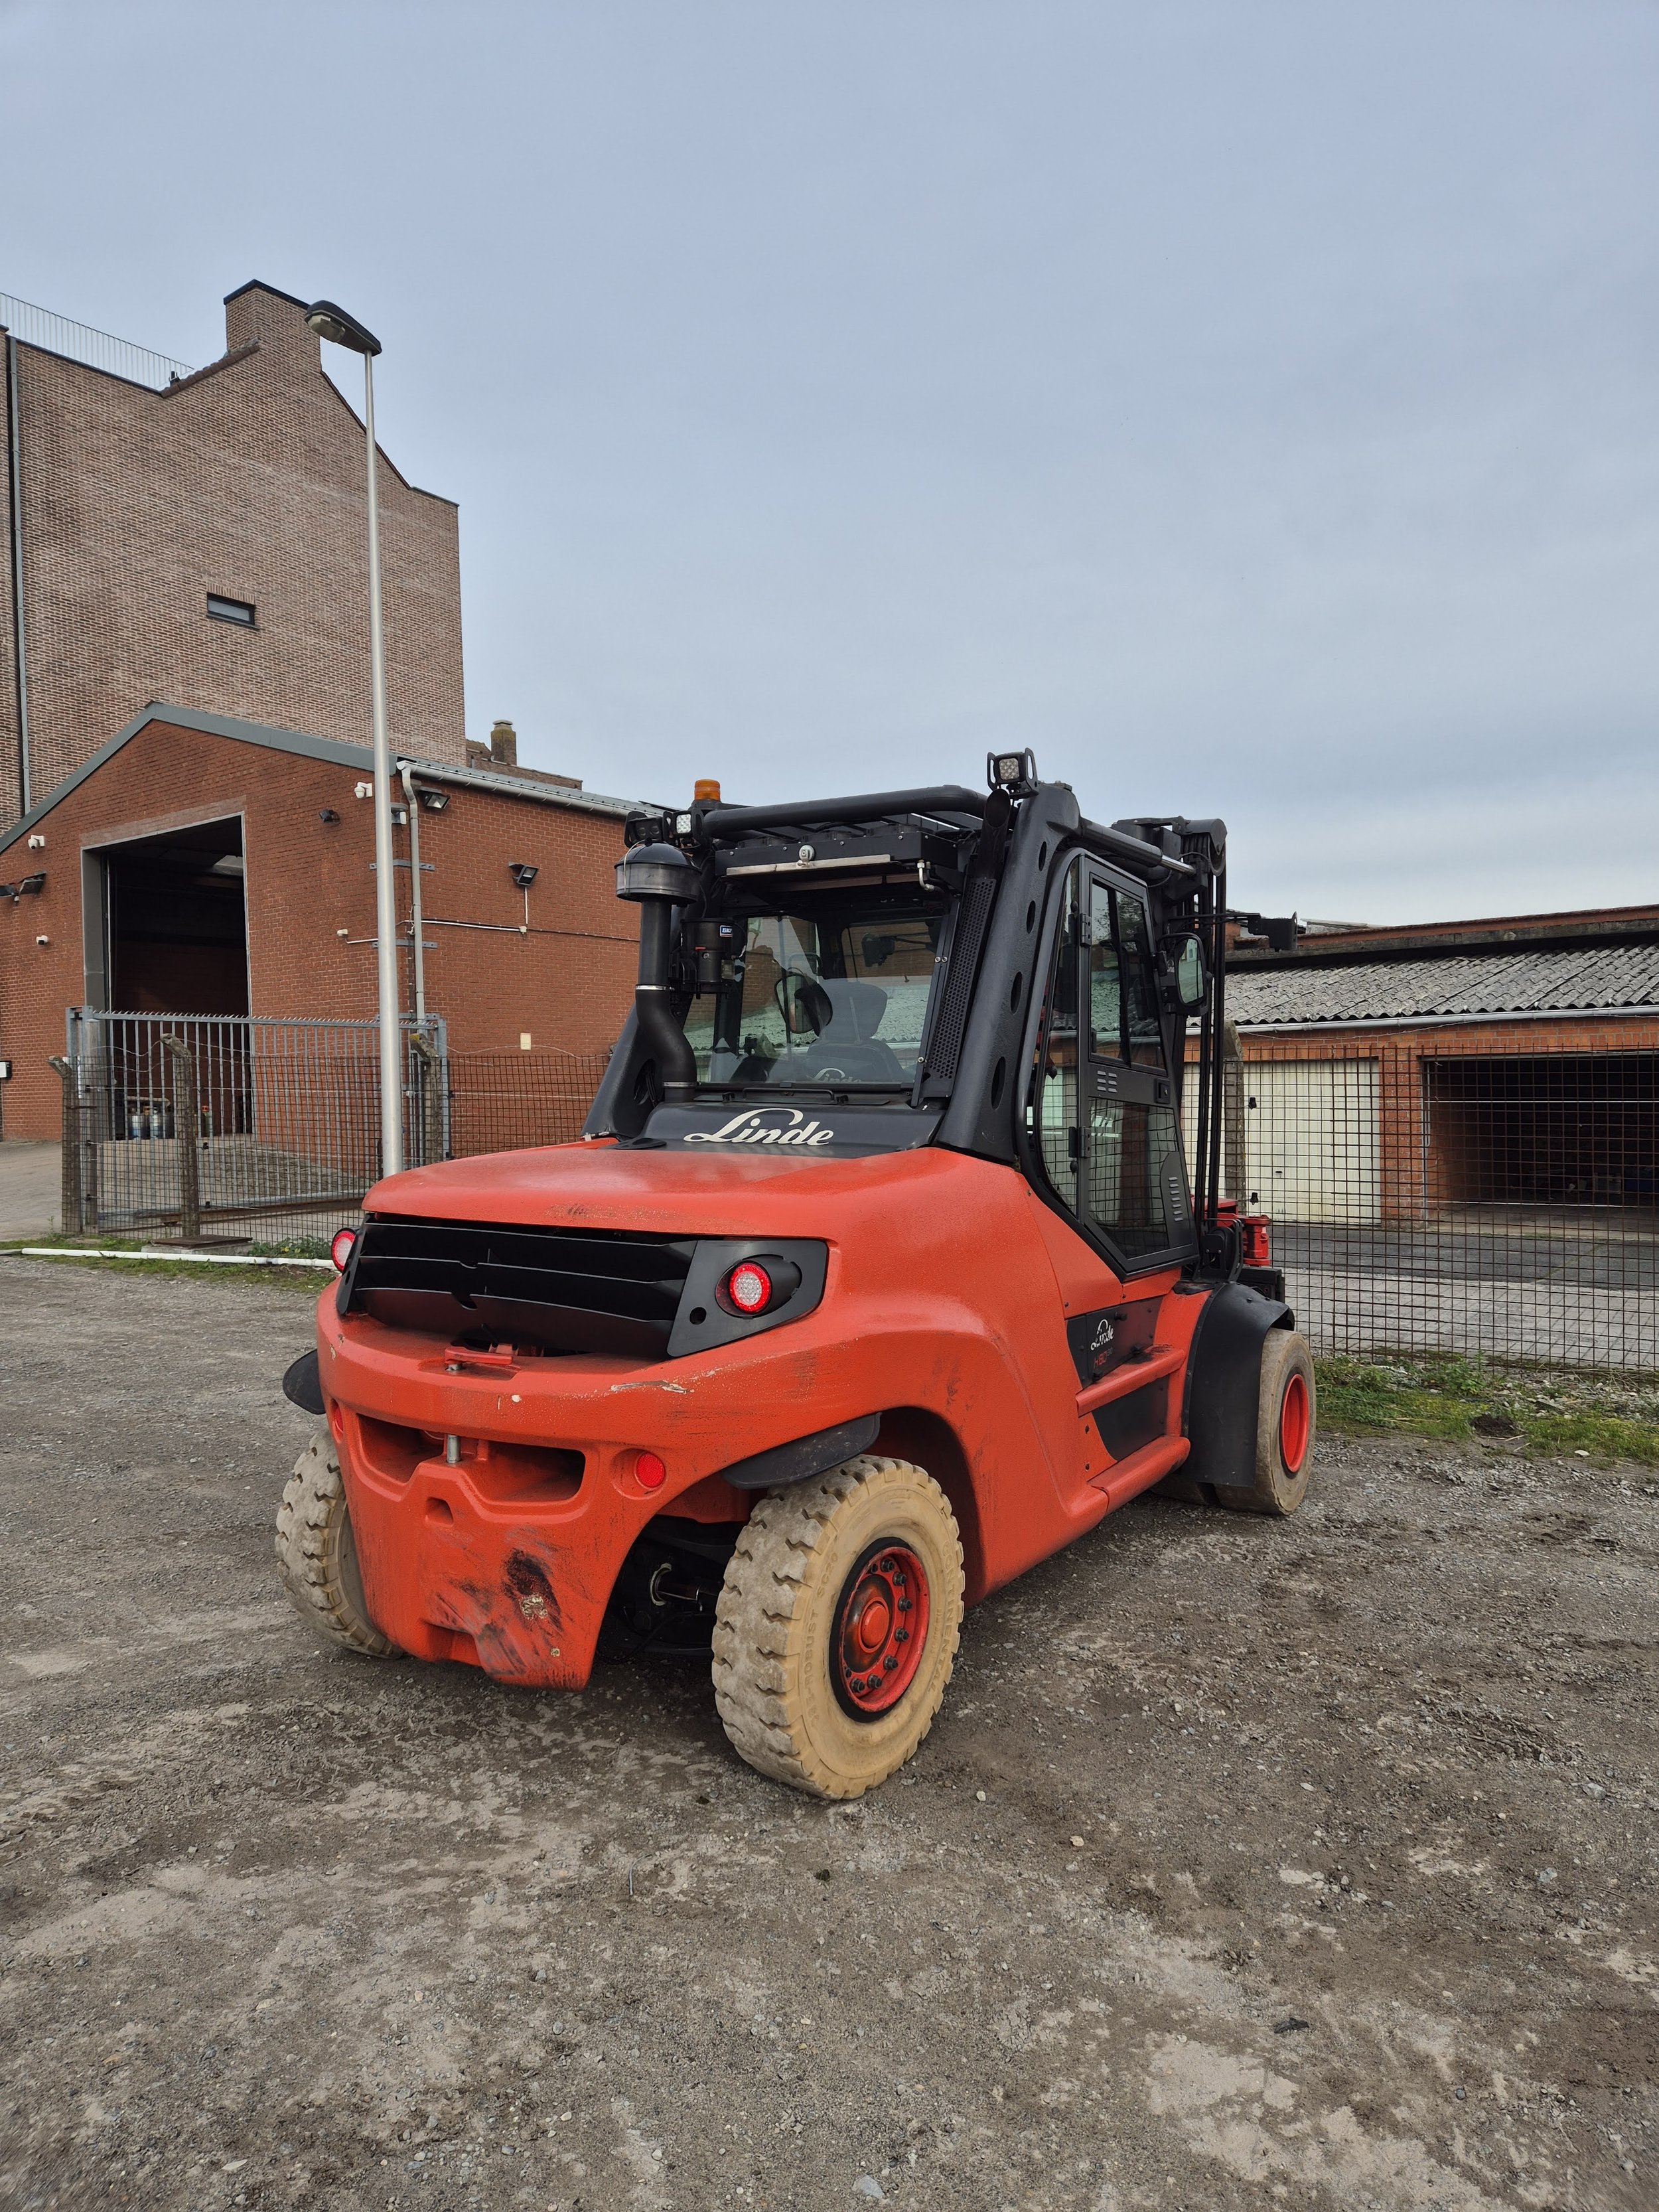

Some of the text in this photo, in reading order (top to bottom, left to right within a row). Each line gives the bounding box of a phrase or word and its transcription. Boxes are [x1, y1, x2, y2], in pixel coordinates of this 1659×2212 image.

[683, 1108, 834, 1145] Linde
[1090, 1319, 1114, 1351] Linde
[928, 1540, 956, 1693] CONTINENTAL
